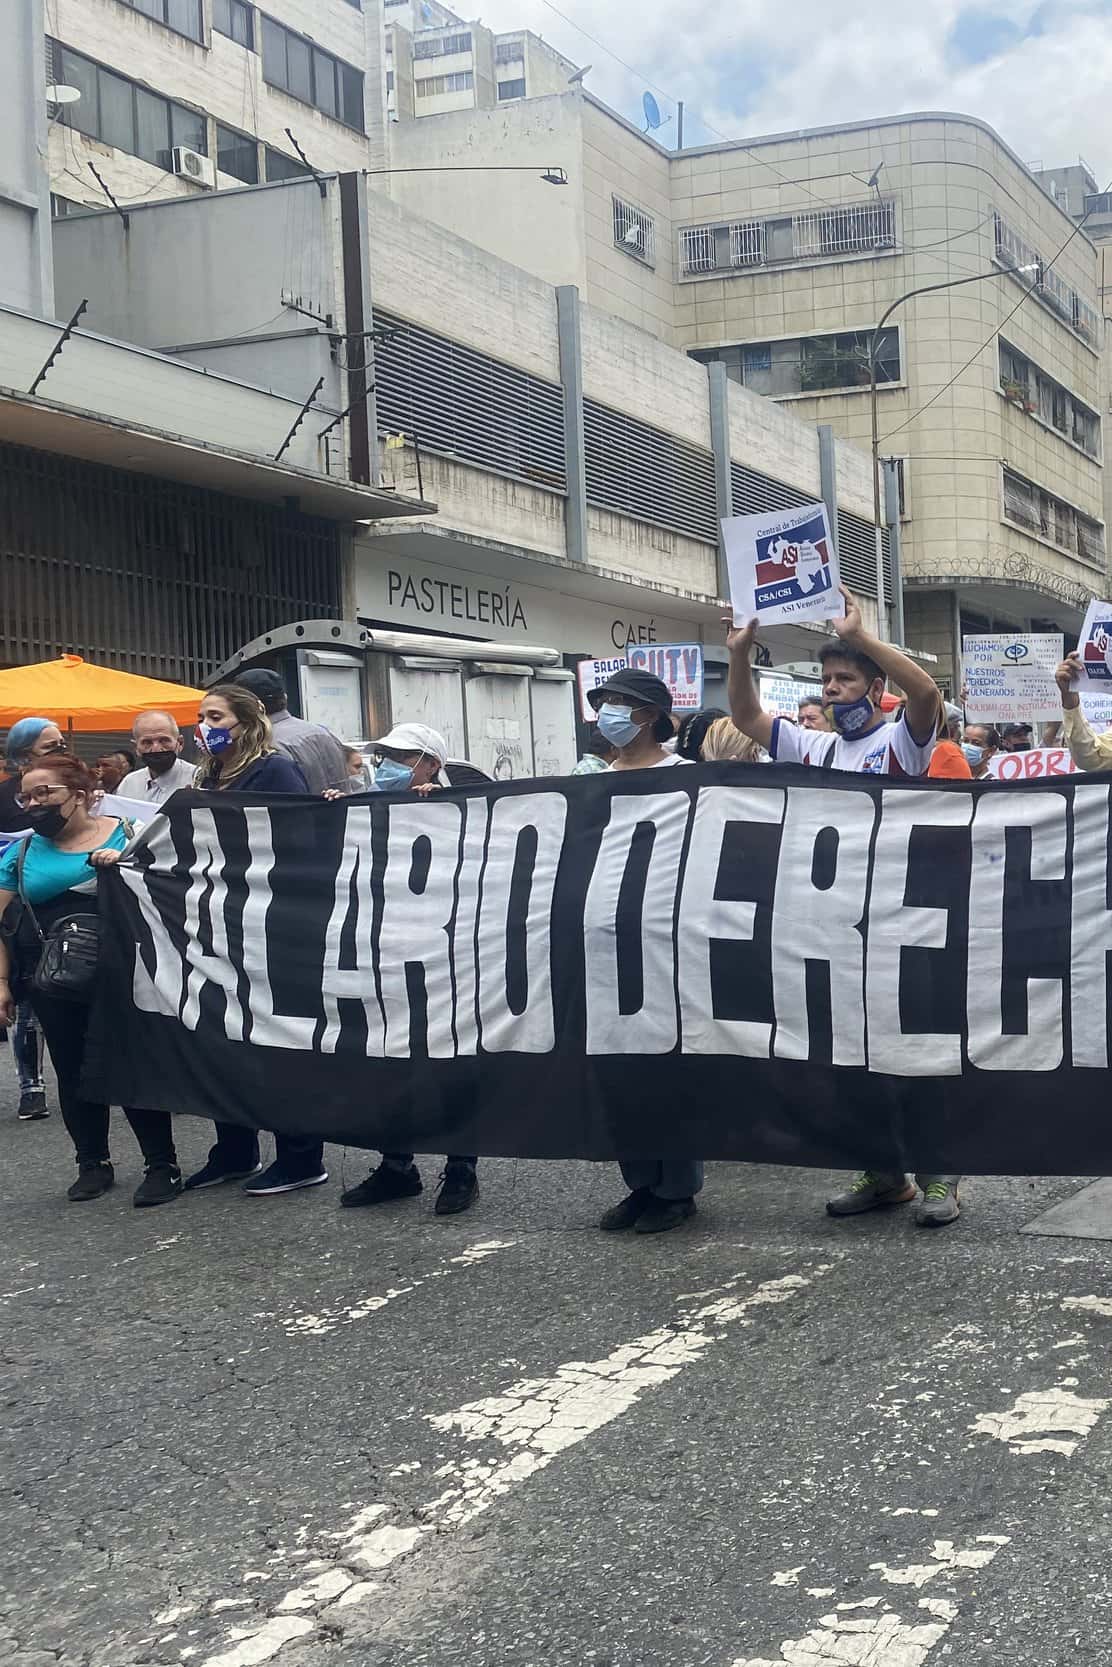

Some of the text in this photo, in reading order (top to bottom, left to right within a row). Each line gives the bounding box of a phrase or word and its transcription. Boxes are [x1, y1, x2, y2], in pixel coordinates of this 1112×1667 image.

[781, 545, 798, 565] ASI
[388, 571, 528, 630] PASTELERÍA
[758, 587, 793, 603] CSA/CSI
[611, 619, 656, 649] CAFÉ
[594, 659, 626, 673] SALAR
[997, 750, 1077, 781] OBR
[119, 791, 568, 1058] SALARIO
